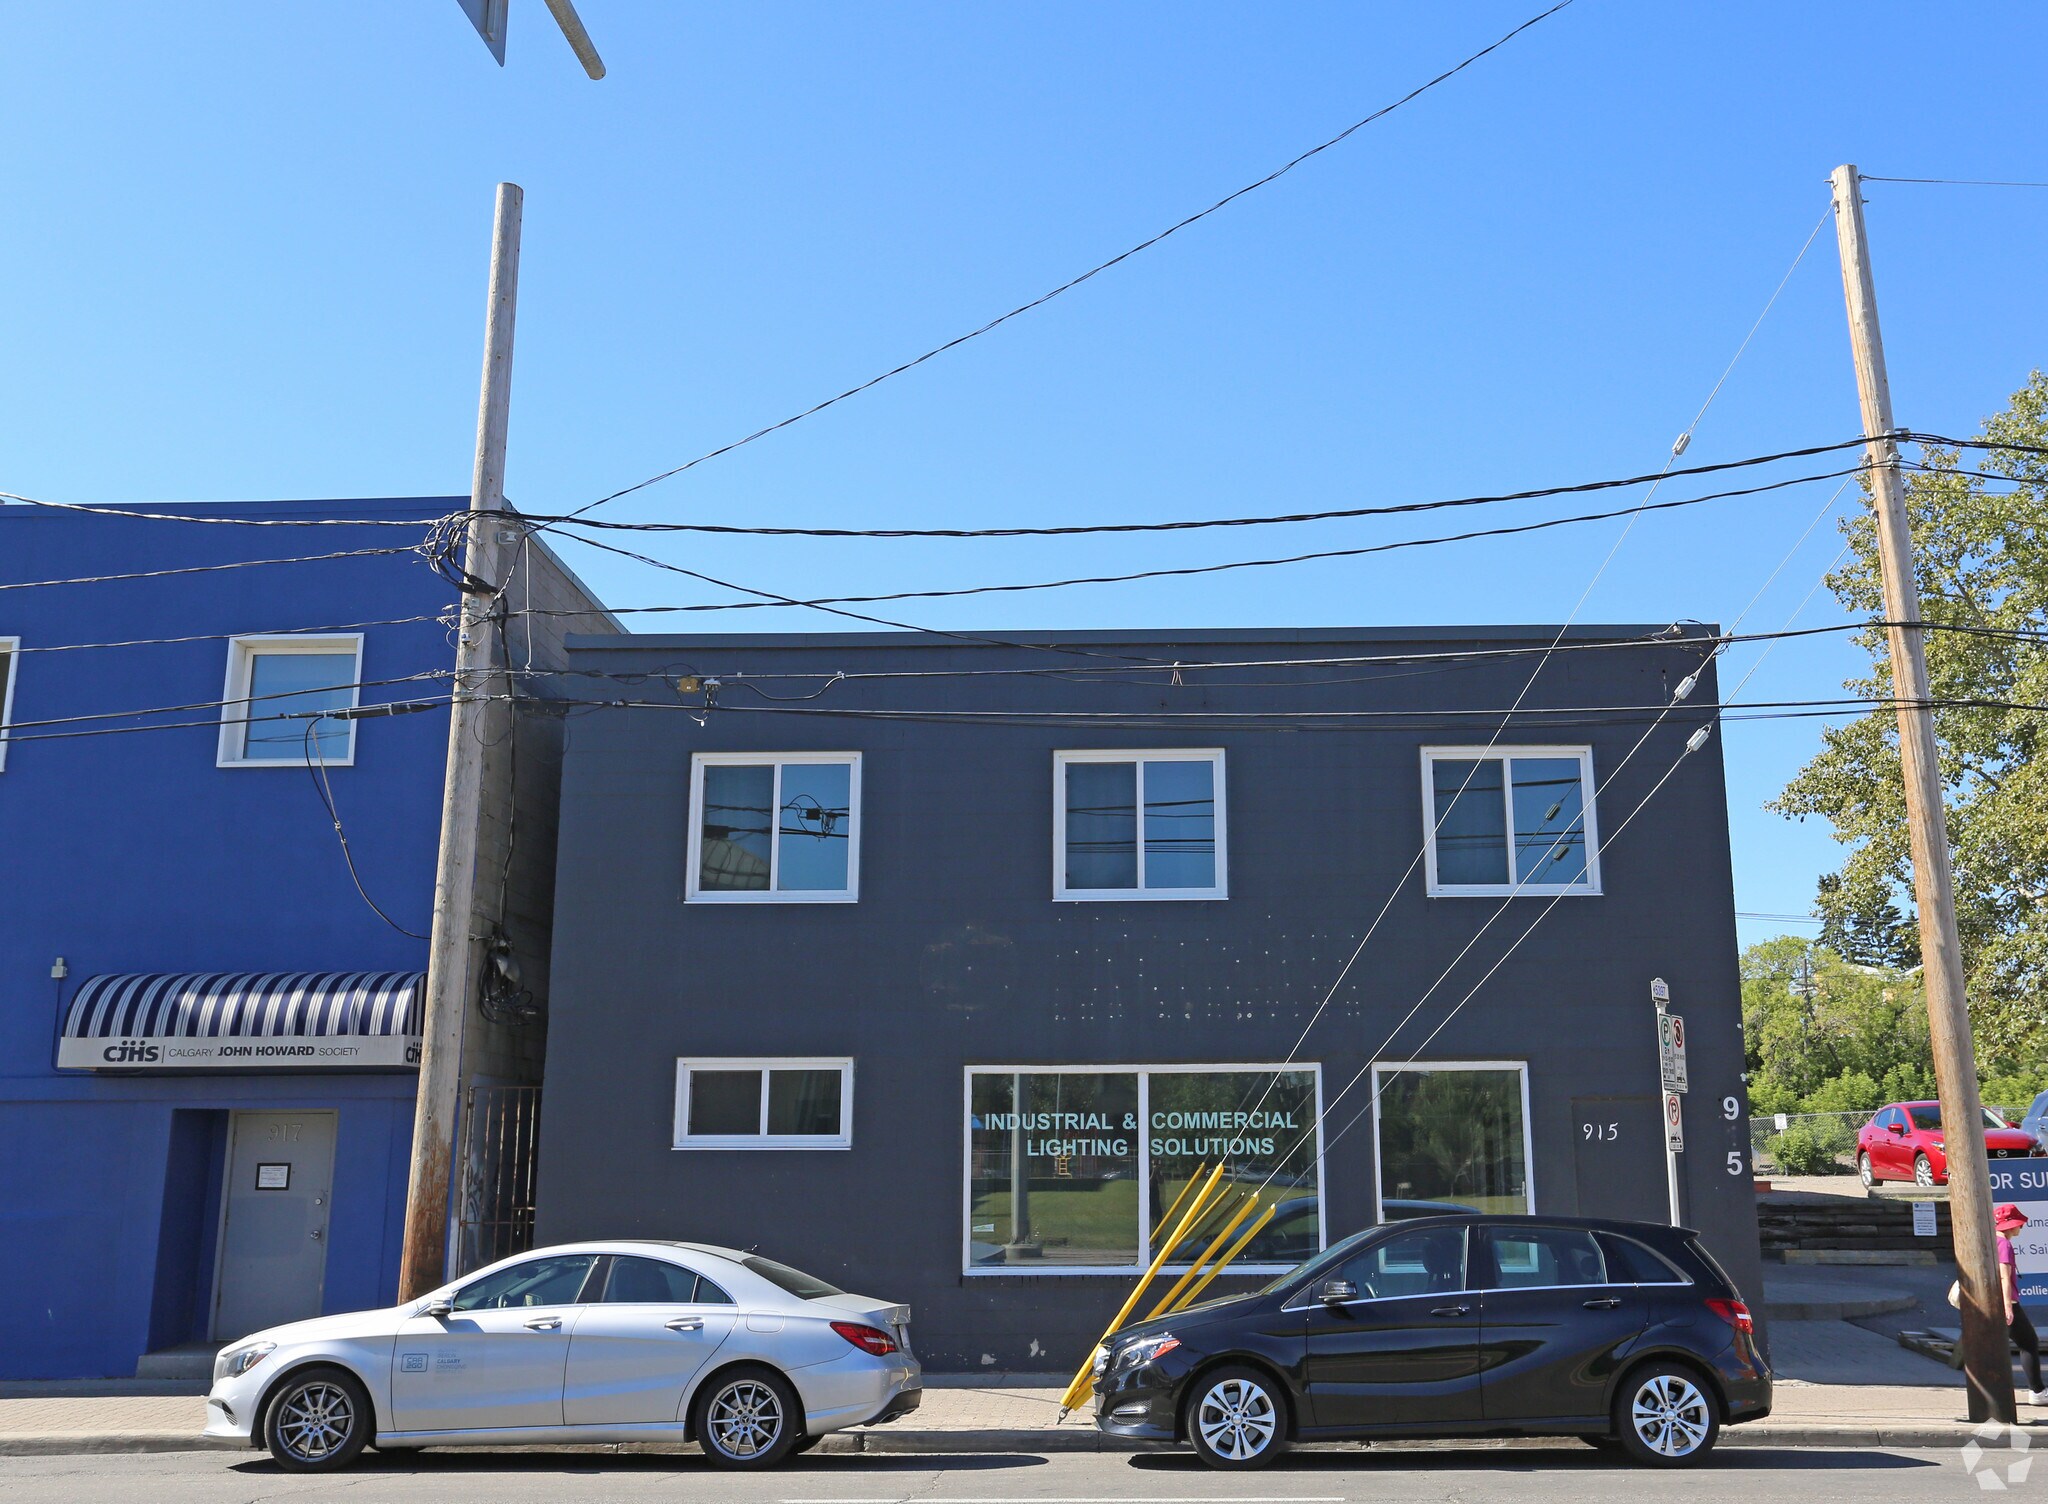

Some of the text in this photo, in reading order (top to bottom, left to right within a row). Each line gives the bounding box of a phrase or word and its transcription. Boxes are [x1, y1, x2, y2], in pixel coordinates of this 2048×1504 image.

[103, 1040, 159, 1062] CJHS
[168, 1045, 360, 1058] CALGARY JOHN HOWARD SOCIETY
[406, 1042, 422, 1063] CJH
[1723, 1096, 1740, 1120] 9
[985, 1111, 1299, 1130] INDUSTRIAL & COMMERCIAL
[267, 1123, 303, 1141] 917
[1583, 1122, 1619, 1140] 915
[1027, 1137, 1275, 1156] LIGHTING SOLUTIONS
[1726, 1151, 1743, 1175] 5
[1989, 1171, 2048, 1189] OR SU
[2018, 1285, 2048, 1296] .collie
